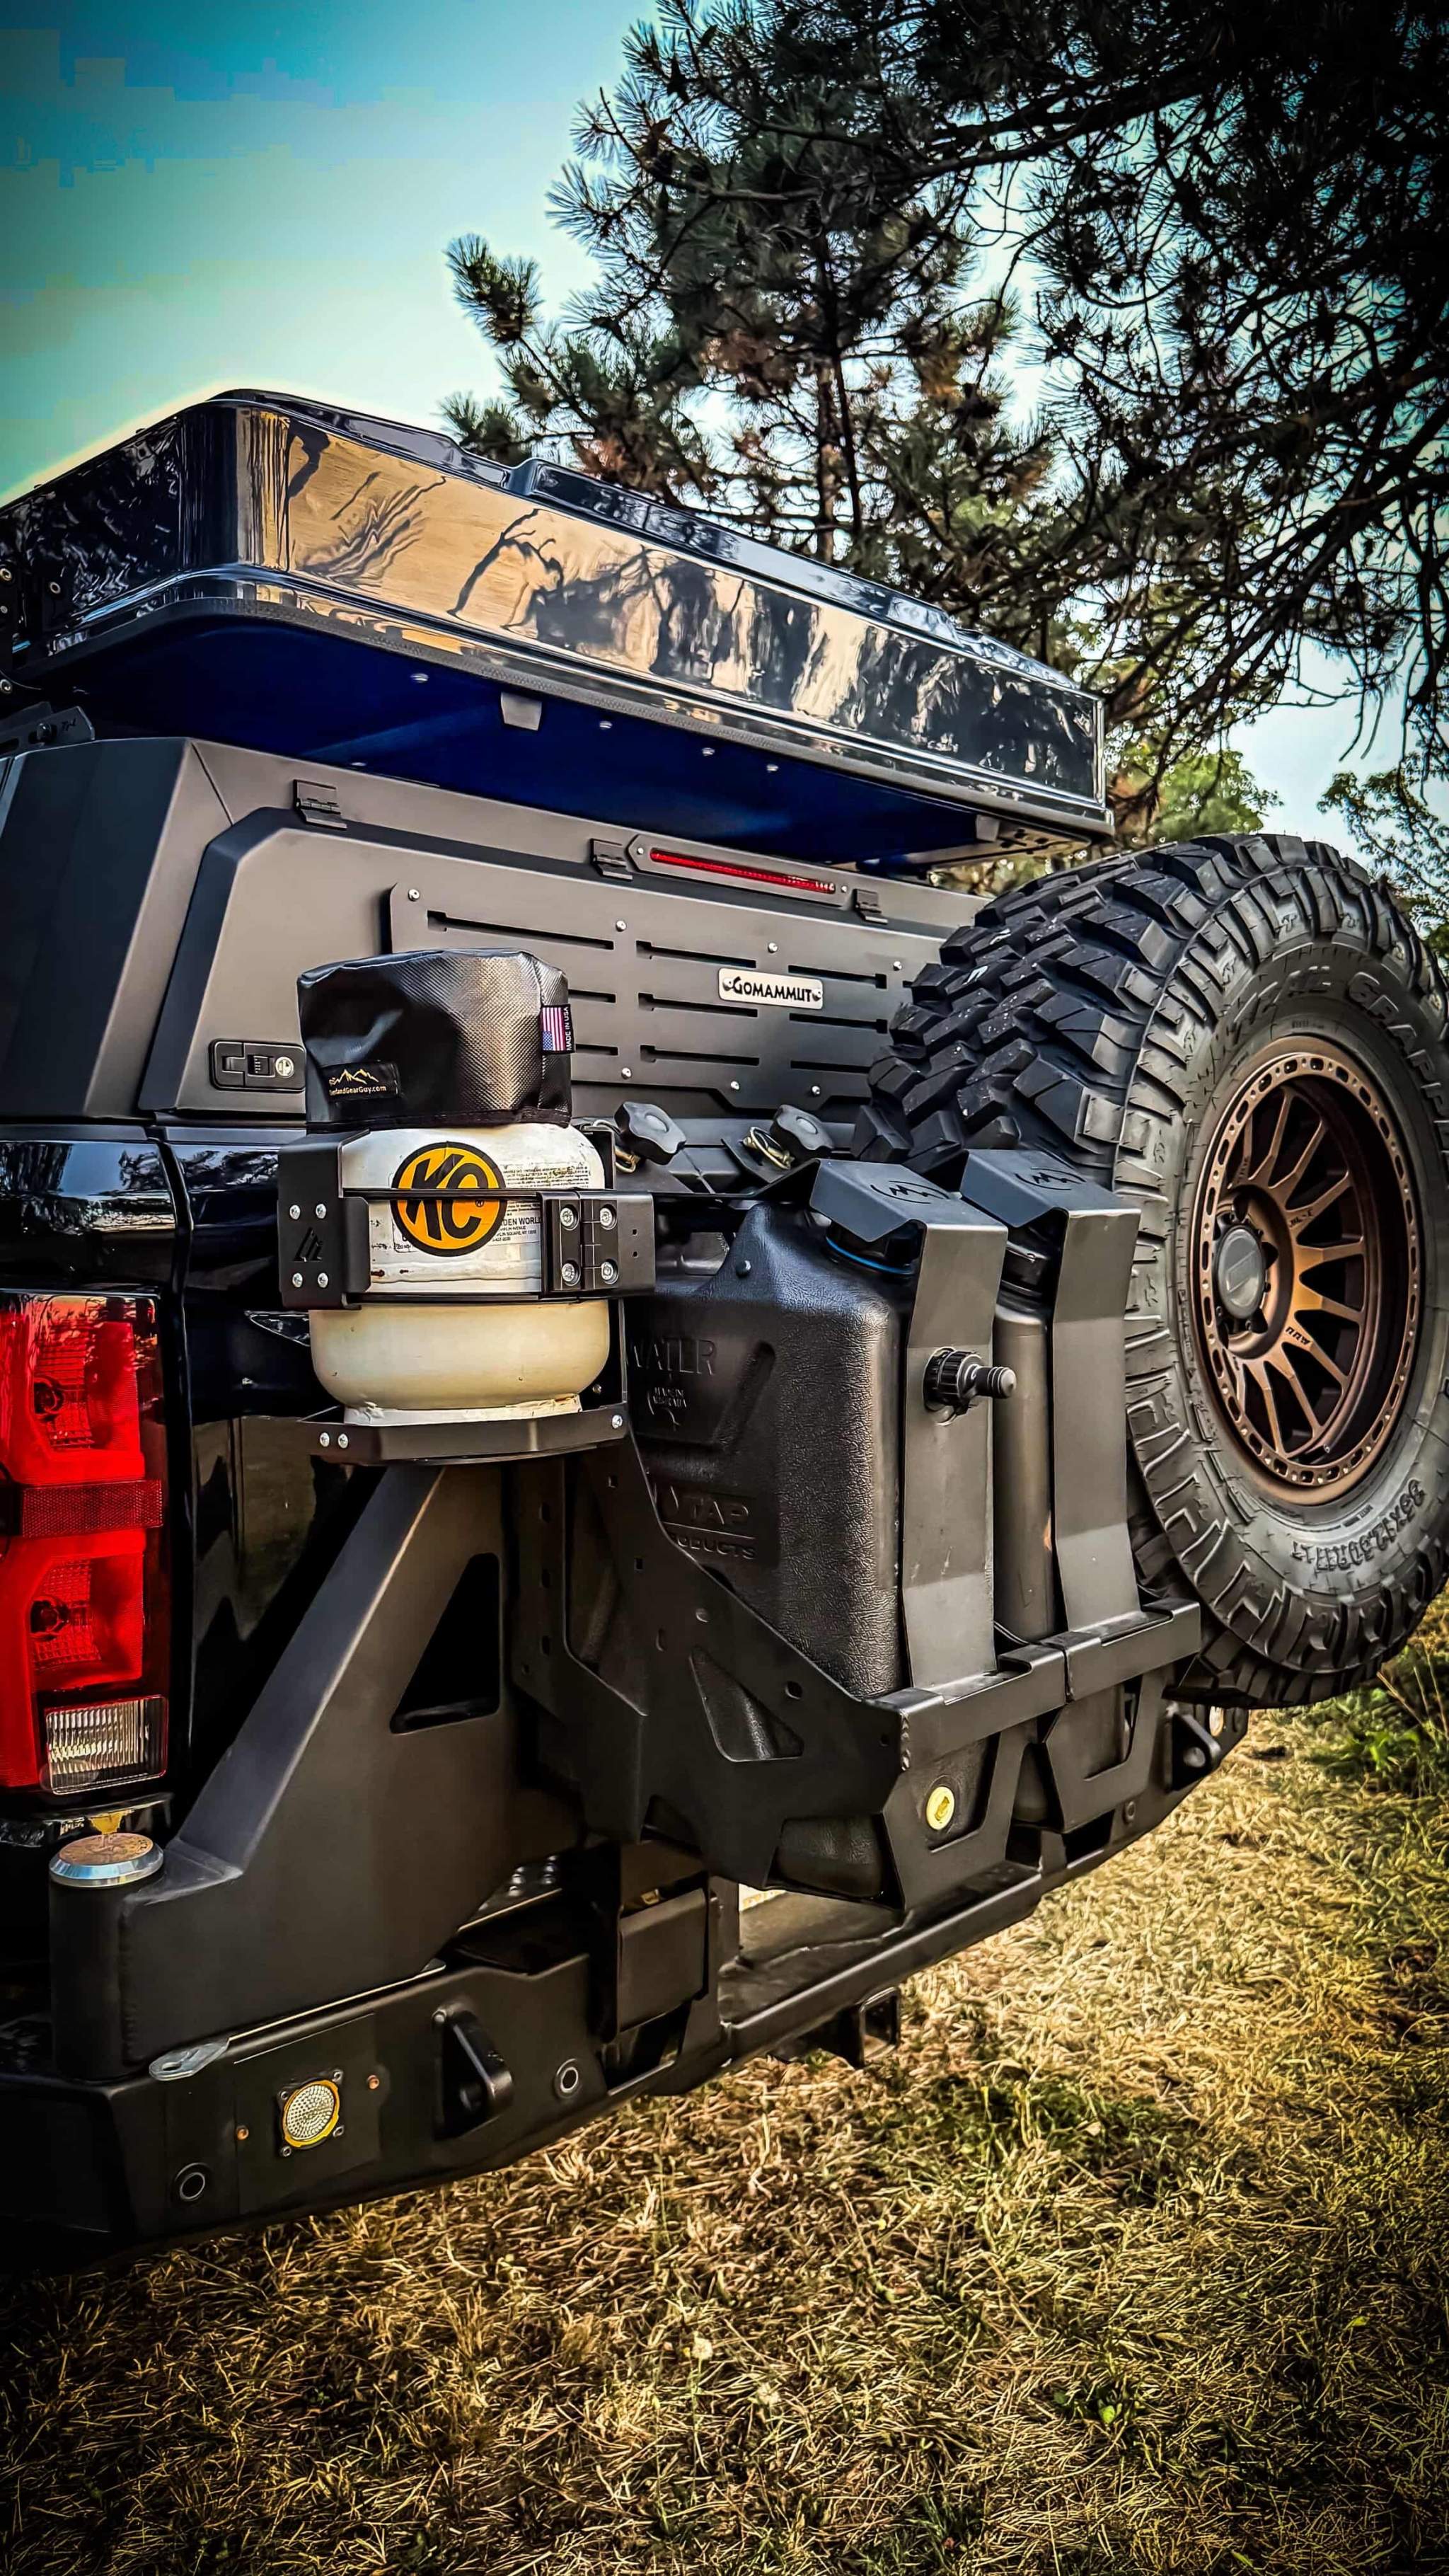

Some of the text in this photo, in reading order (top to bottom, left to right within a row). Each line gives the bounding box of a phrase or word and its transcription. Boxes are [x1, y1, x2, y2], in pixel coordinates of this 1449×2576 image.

[732, 976, 812, 1002] GOMAMMUT
[565, 1022, 571, 1030] IN
[405, 1154, 489, 1241] KC
